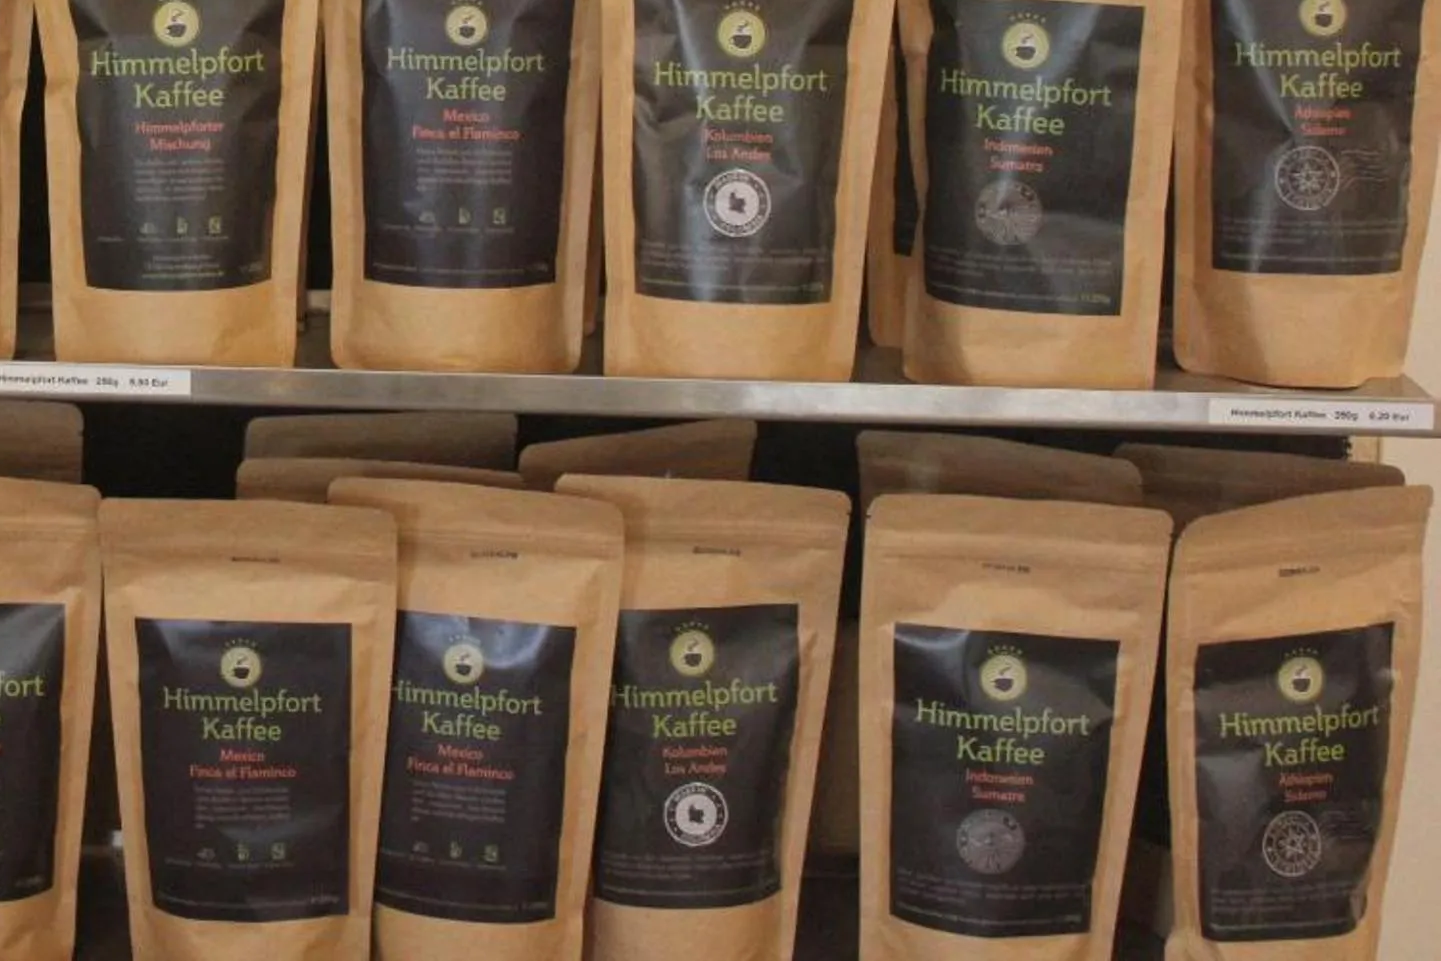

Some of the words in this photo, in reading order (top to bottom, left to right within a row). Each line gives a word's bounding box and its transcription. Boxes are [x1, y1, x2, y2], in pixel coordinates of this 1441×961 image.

[90, 47, 265, 80] Himmelpfort
[386, 46, 545, 75] Himmelpfort
[1235, 42, 1402, 73] Himmelpfort
[425, 76, 507, 102] Kaffee
[652, 62, 829, 93] Himmelpfort
[940, 69, 1113, 108] Himmelpfort
[1279, 73, 1364, 99] Kaffee
[133, 82, 225, 108] Kaffee
[694, 95, 786, 124] Kaffee
[443, 108, 490, 122] Mexico
[975, 104, 1066, 137] Kaffee
[989, 156, 1044, 173] Sumatra
[162, 685, 323, 715] Himmelpfort
[613, 679, 779, 709] Himmelpfort
[202, 717, 283, 742] Kaffee
[422, 712, 502, 741] Kaffee
[651, 712, 738, 739] Kaffee
[915, 698, 1091, 738] Himmelpfort
[1218, 701, 1381, 739] Himmelpfort
[219, 748, 266, 763] Mexico
[437, 742, 485, 760] Mexico
[956, 735, 1045, 765] Kaffee
[1263, 740, 1346, 768] Kaffee
[189, 764, 223, 779] Finca
[226, 765, 238, 779] el
[239, 764, 298, 779] Flaminco
[406, 758, 441, 775] Finca
[443, 763, 455, 777] el
